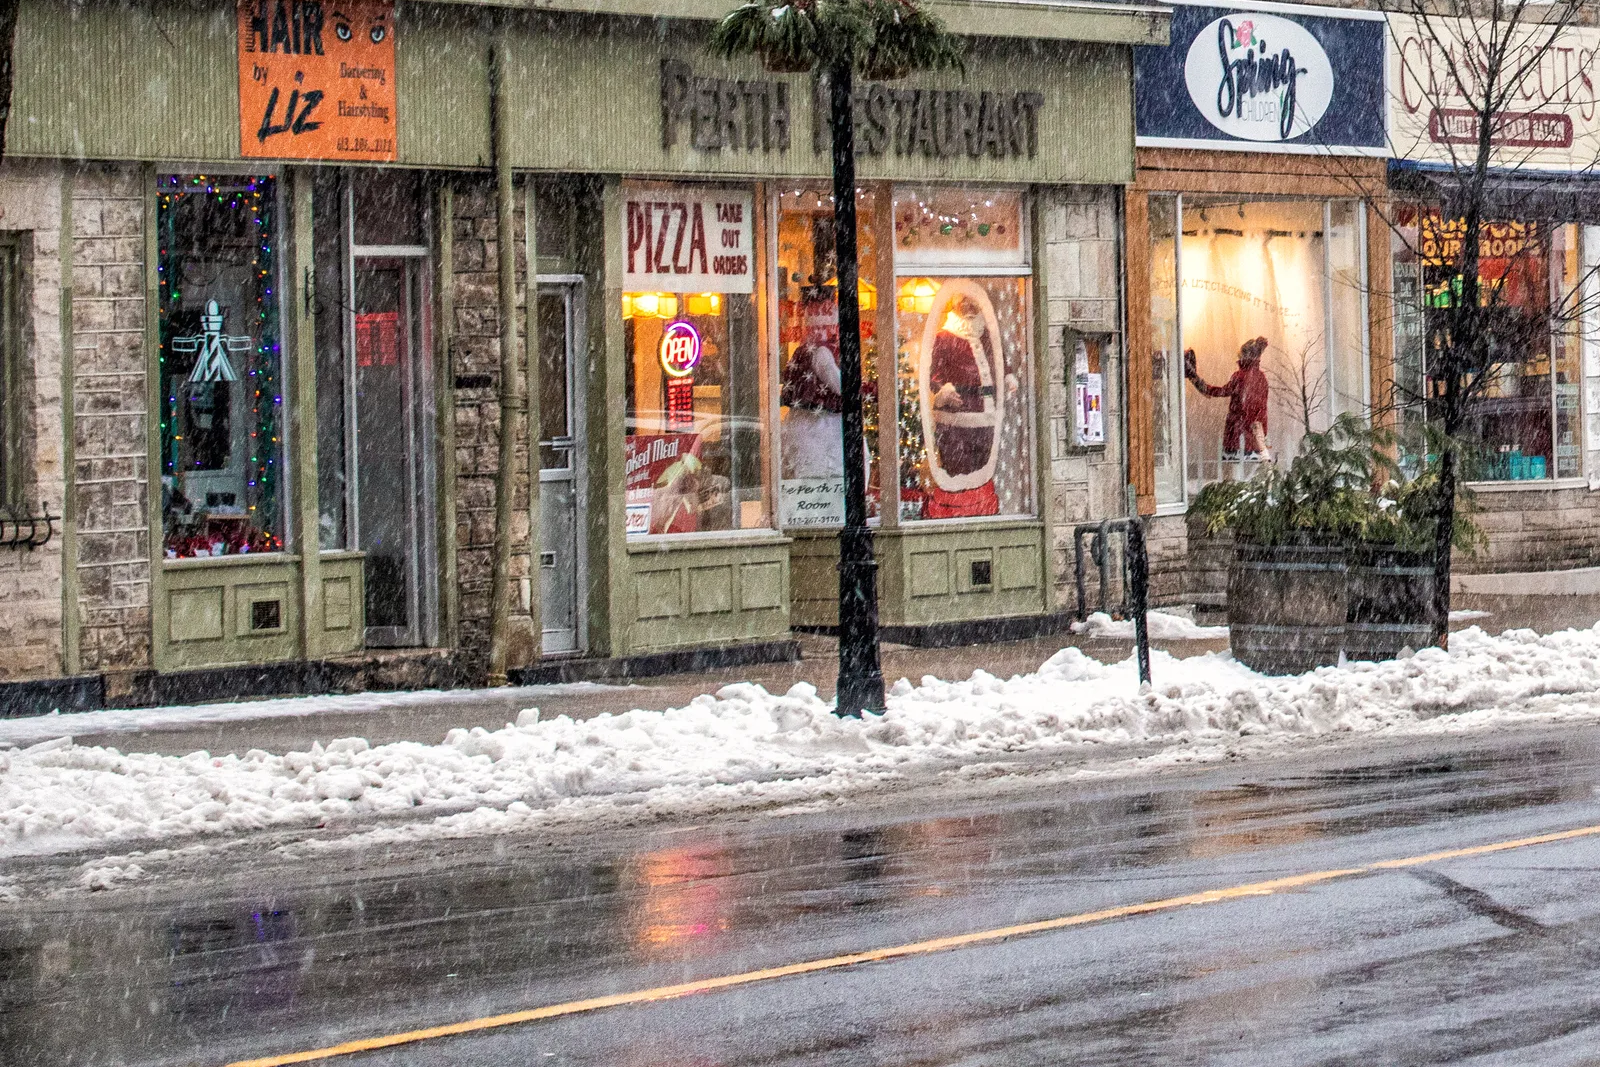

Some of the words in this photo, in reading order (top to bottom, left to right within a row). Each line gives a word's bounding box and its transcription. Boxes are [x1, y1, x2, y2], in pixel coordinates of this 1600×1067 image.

[253, 63, 268, 85] by
[1217, 18, 1308, 139] Spring
[359, 84, 367, 100] &
[660, 58, 791, 154] PERTH
[715, 202, 743, 224] TAKE
[626, 200, 709, 275] PIZZA
[721, 229, 741, 249] OUT
[1478, 238, 1542, 258] ROOPS
[713, 255, 748, 276] ORDERS
[666, 336, 694, 363] OPEN
[625, 443, 651, 476] oked
[652, 438, 680, 463] Meat
[796, 483, 832, 495] Perth
[796, 500, 831, 511] Room
